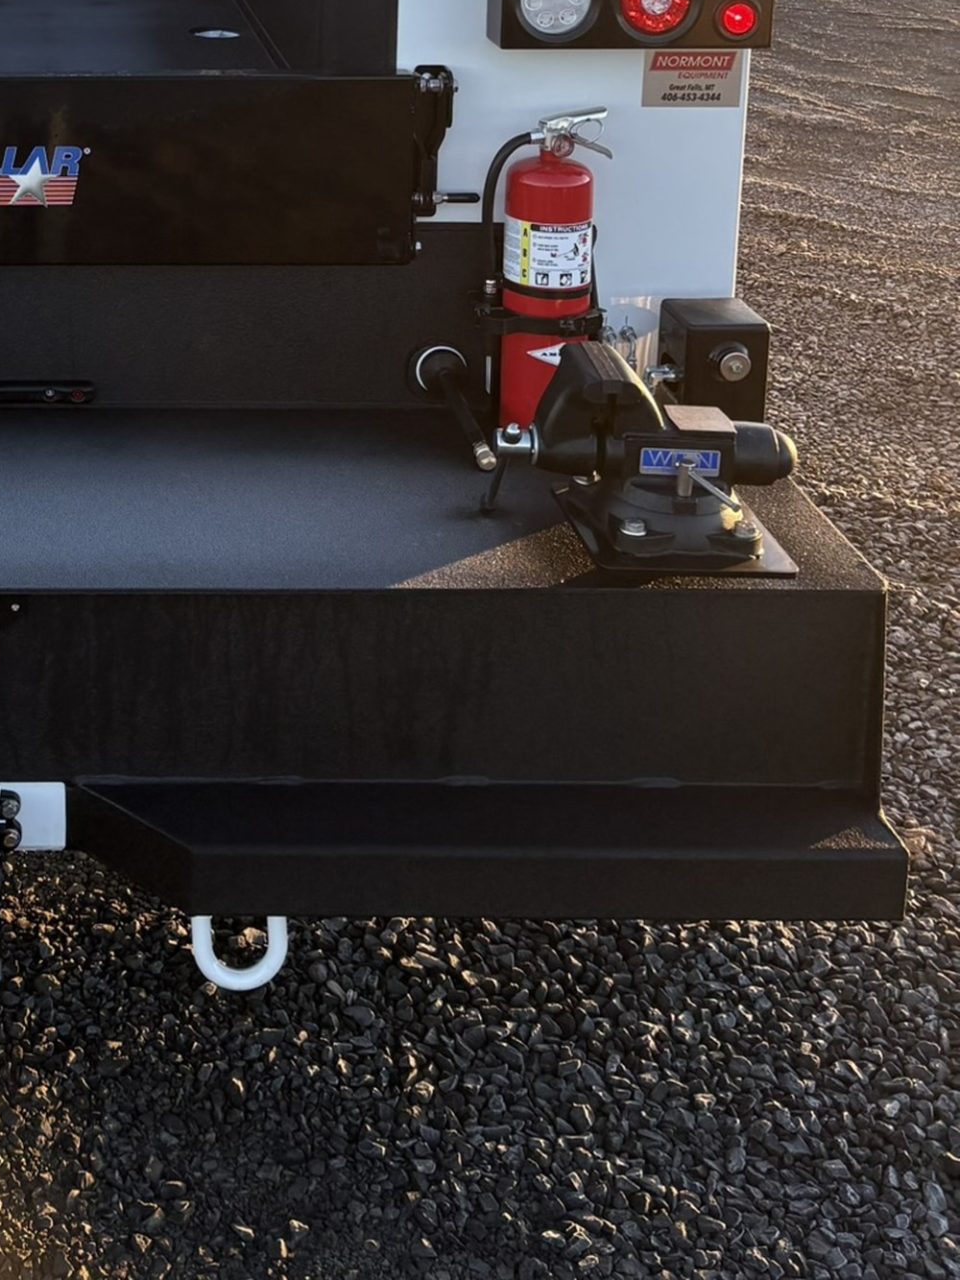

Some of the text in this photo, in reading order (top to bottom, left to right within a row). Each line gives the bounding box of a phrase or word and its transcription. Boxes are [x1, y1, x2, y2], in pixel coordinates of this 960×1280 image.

[656, 55, 730, 67] NORMONT
[669, 83, 686, 91] Great
[704, 83, 715, 91] MT
[661, 93, 721, 101] 406-453-4344
[523, 227, 528, 238] A
[522, 248, 527, 258] B
[522, 269, 527, 278] C
